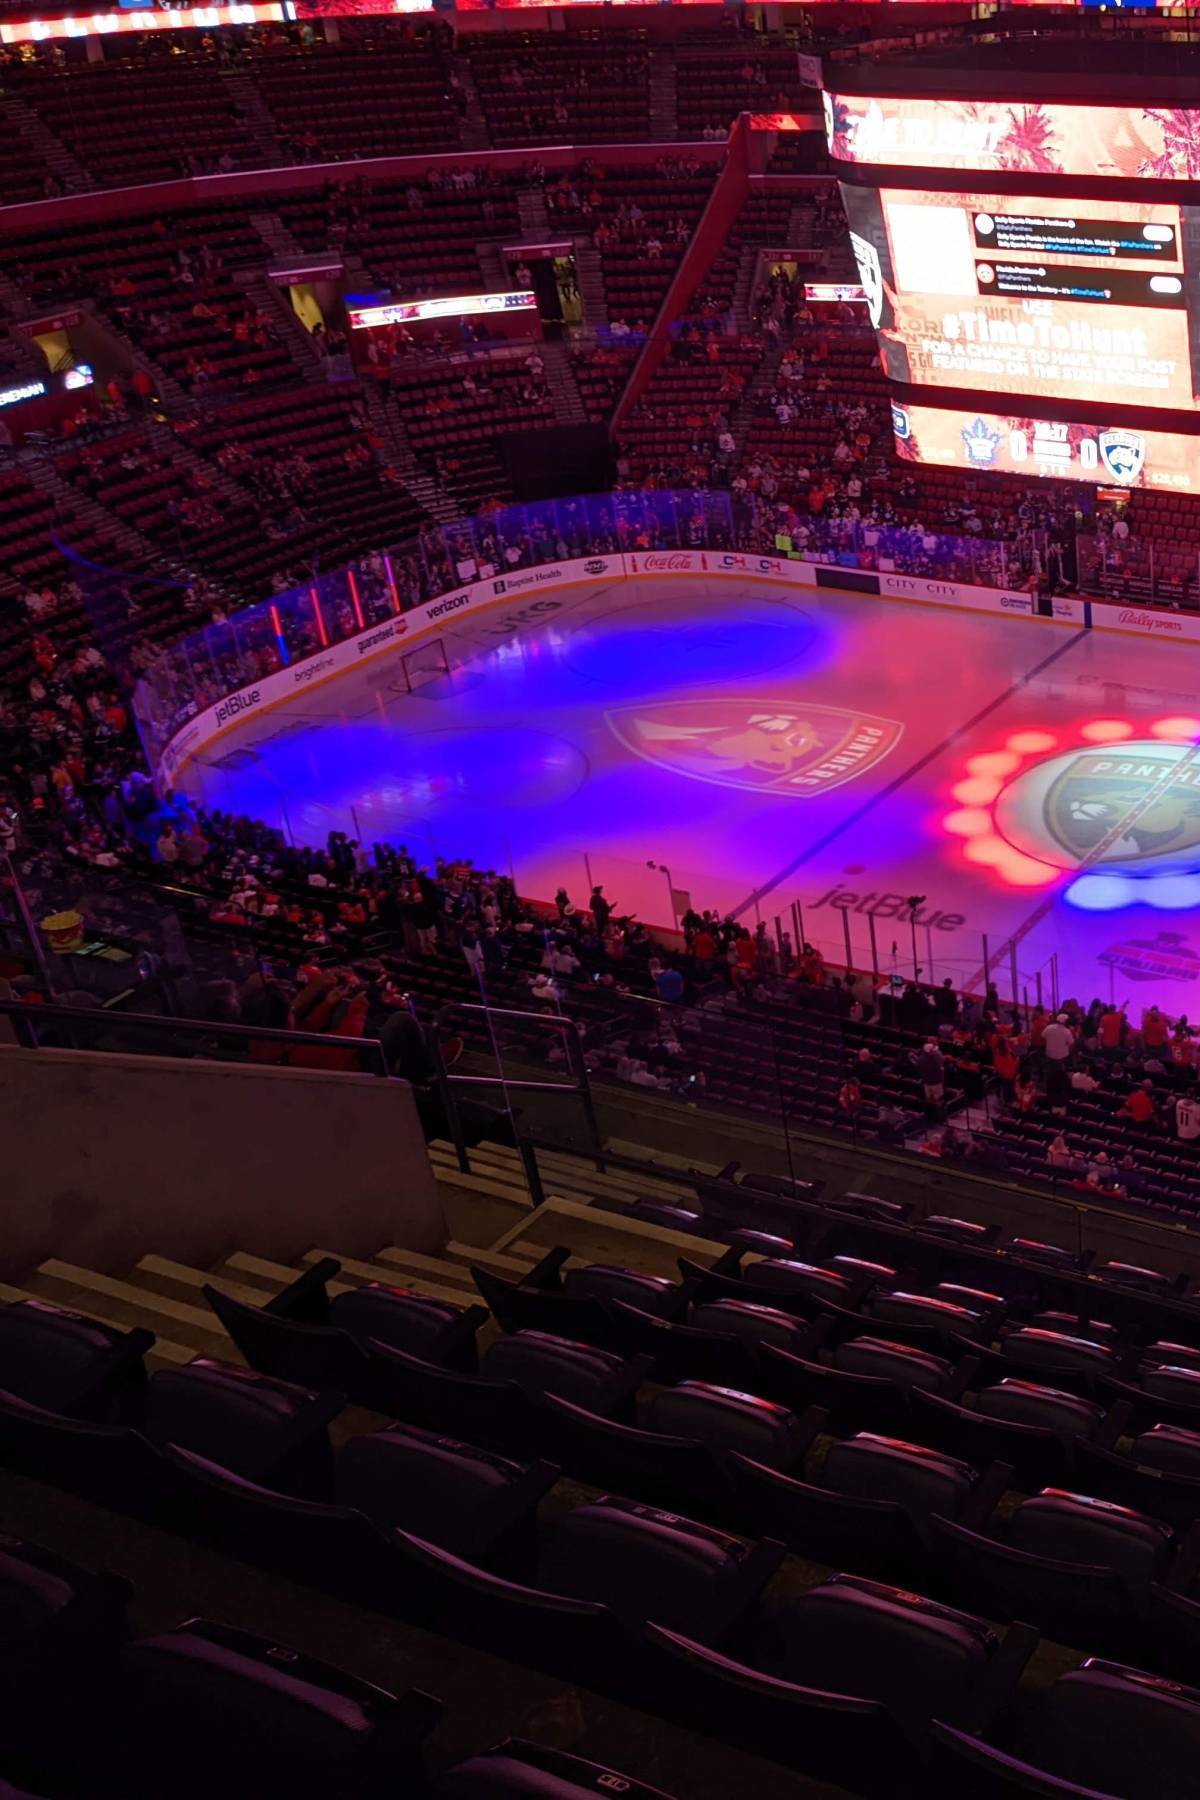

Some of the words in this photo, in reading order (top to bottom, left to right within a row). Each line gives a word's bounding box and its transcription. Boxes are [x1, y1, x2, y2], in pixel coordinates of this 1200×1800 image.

[943, 311, 1147, 355] #TimeToHunt
[535, 569, 562, 581] Health
[887, 577, 916, 590] CITY
[927, 584, 957, 596] CITY
[426, 593, 469, 619] verizon
[1119, 610, 1155, 630] Bally
[1155, 620, 1182, 631] SPORTS
[214, 690, 261, 728] jetBlue
[791, 725, 883, 786] PANTHERS
[807, 884, 966, 931] jetBlue
[1180, 1112, 1189, 1126] 11
